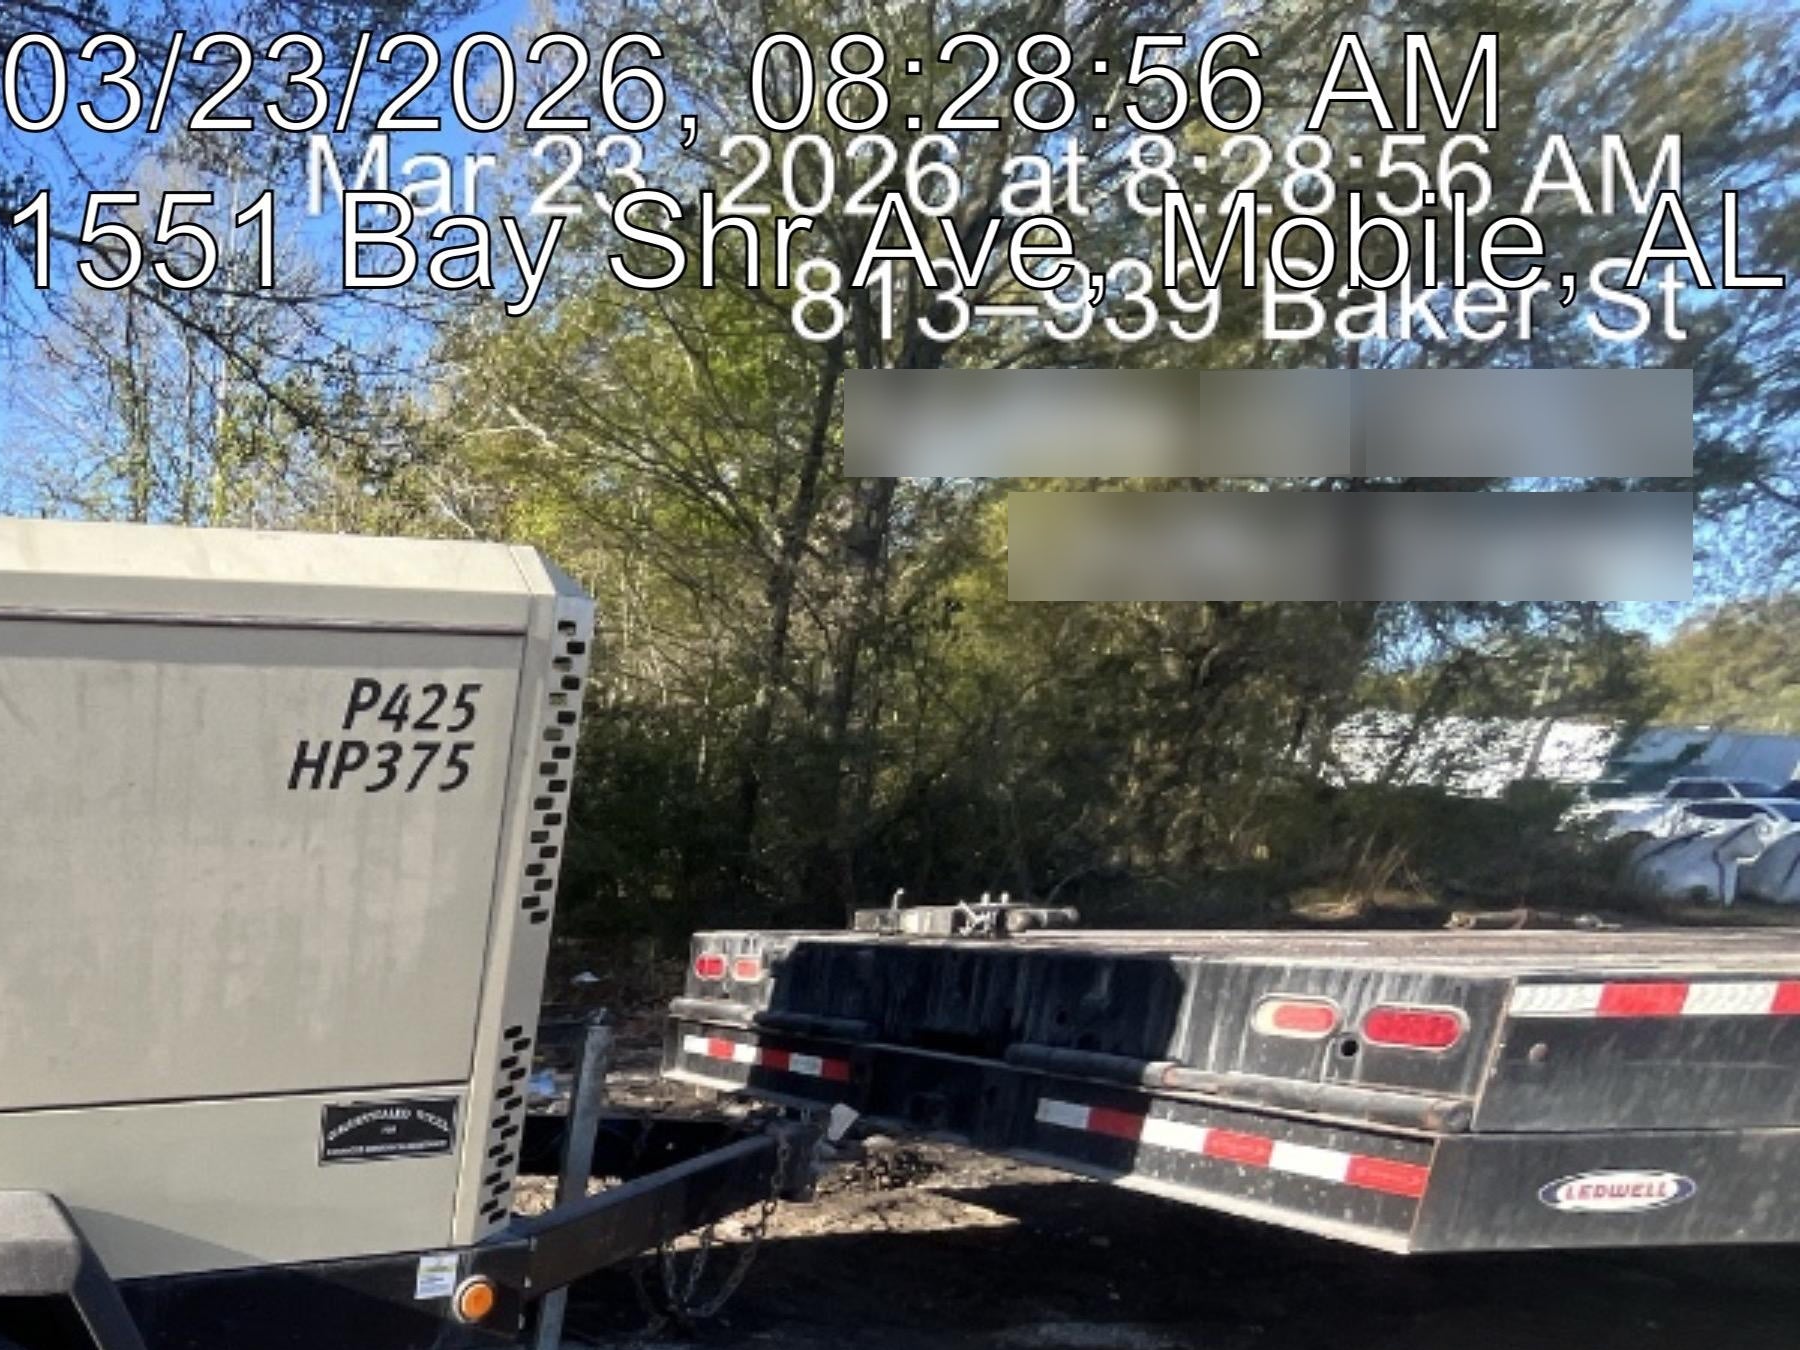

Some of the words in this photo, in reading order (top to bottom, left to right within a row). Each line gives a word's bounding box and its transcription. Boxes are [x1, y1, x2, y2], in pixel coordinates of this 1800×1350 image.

[342, 677, 483, 732] P425
[288, 740, 475, 792] HP375
[1564, 1181, 1668, 1201] LEDWELL
